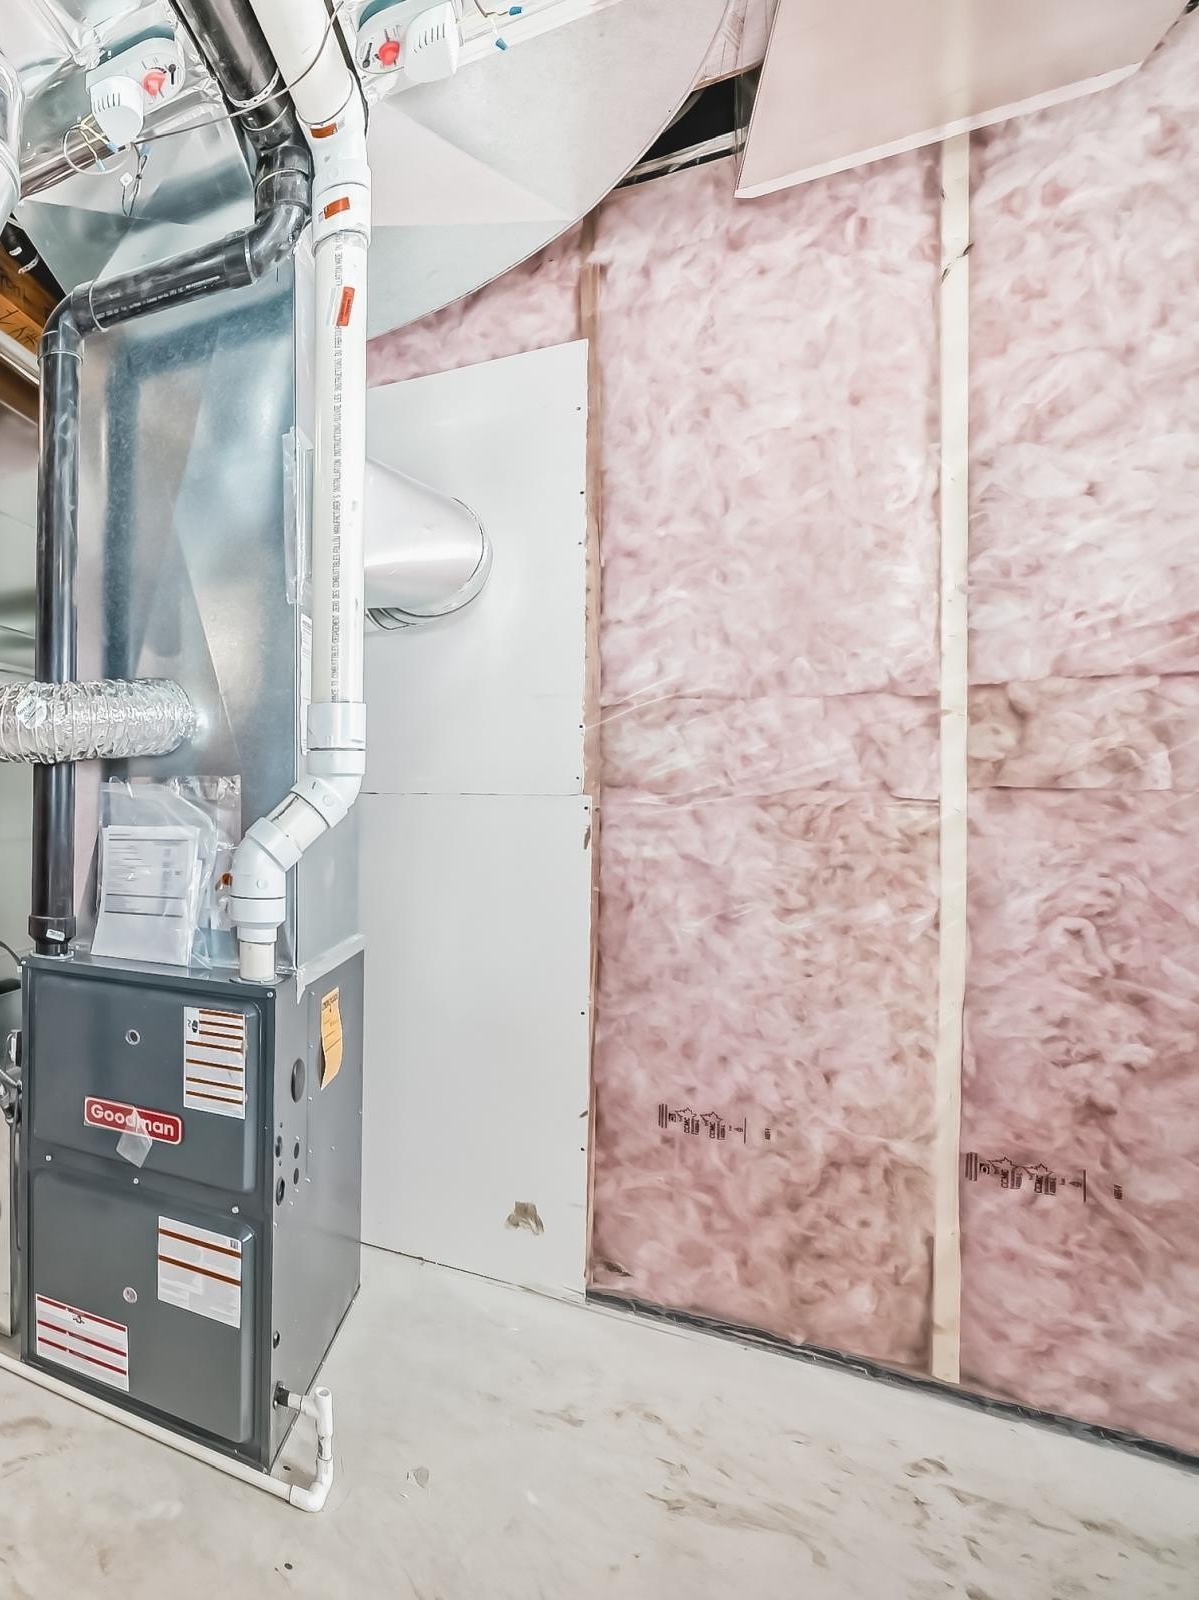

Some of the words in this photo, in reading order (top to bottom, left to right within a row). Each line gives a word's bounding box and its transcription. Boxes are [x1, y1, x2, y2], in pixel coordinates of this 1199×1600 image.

[90, 1103, 175, 1137] Goodman
[683, 1117, 691, 1134] CCMC
[708, 1121, 716, 1139] CCMC
